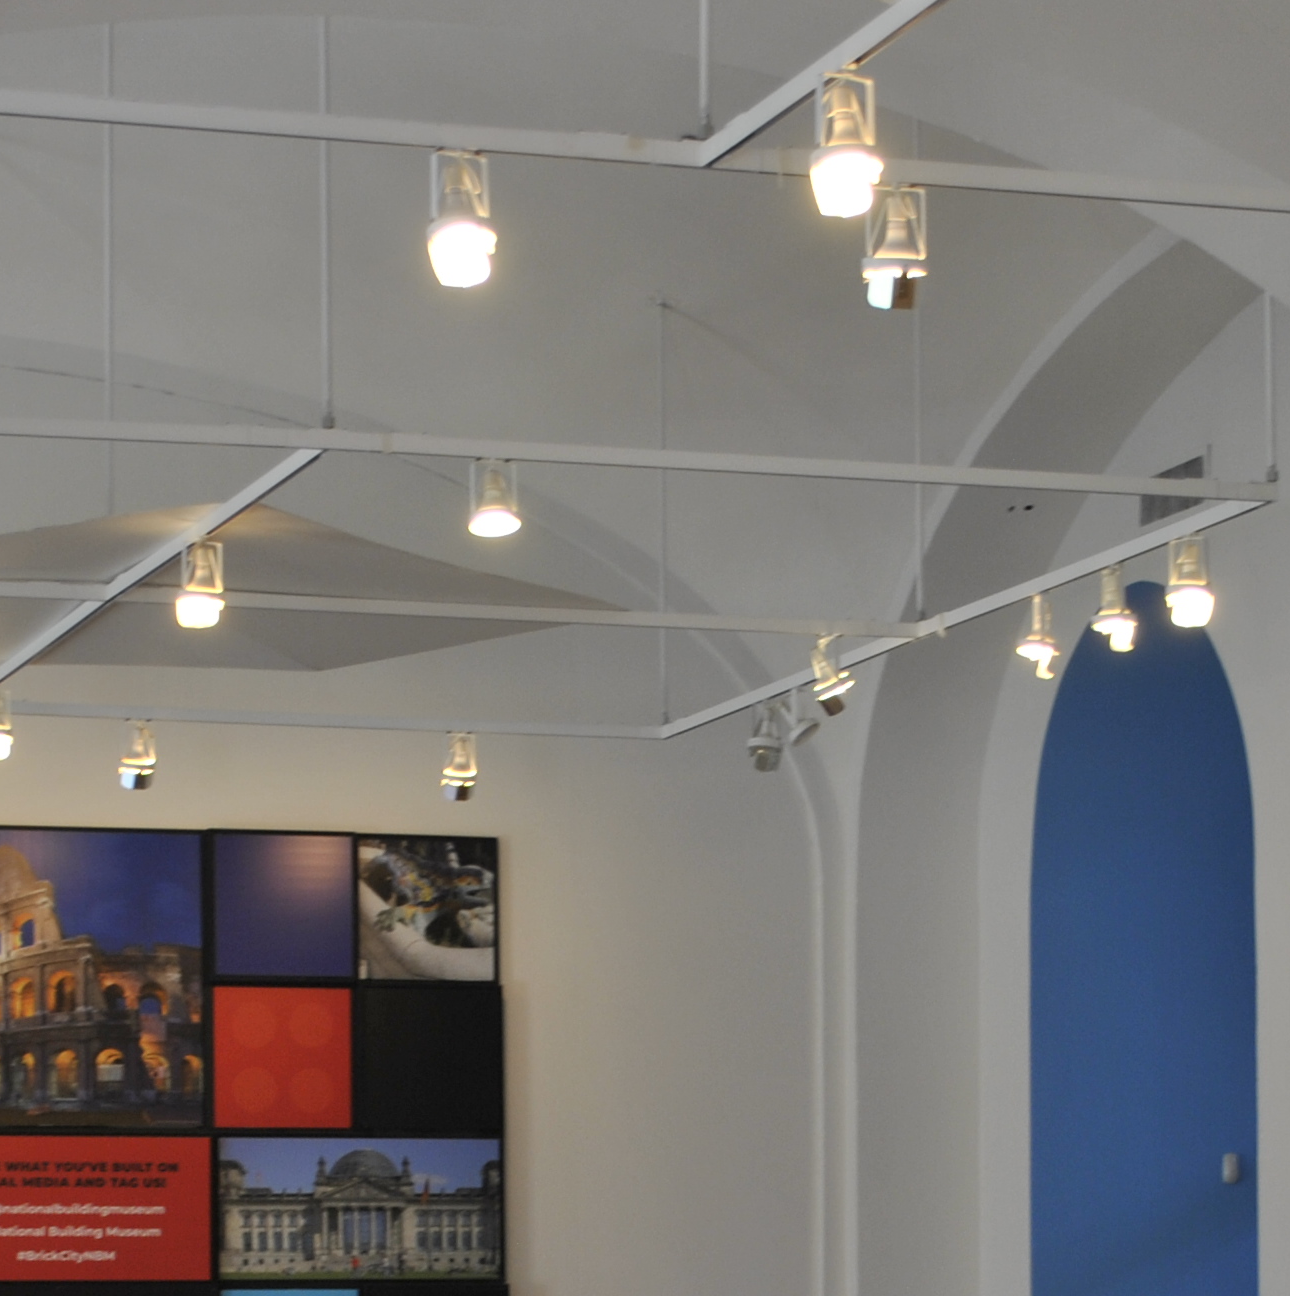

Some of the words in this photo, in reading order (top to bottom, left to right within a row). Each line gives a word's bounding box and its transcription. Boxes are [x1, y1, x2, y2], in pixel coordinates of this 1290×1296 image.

[5, 1161, 49, 1173] WHAT
[112, 1162, 153, 1173] BUILT
[158, 1162, 179, 1173] ON
[23, 1177, 69, 1188] MEDIA
[75, 1177, 106, 1188] AND
[111, 1177, 139, 1188] TAG
[143, 1177, 166, 1188] US!
[48, 1226, 104, 1240] Building
[106, 1227, 161, 1238] Museum
[16, 1250, 116, 1263] #BrickCityNBM
